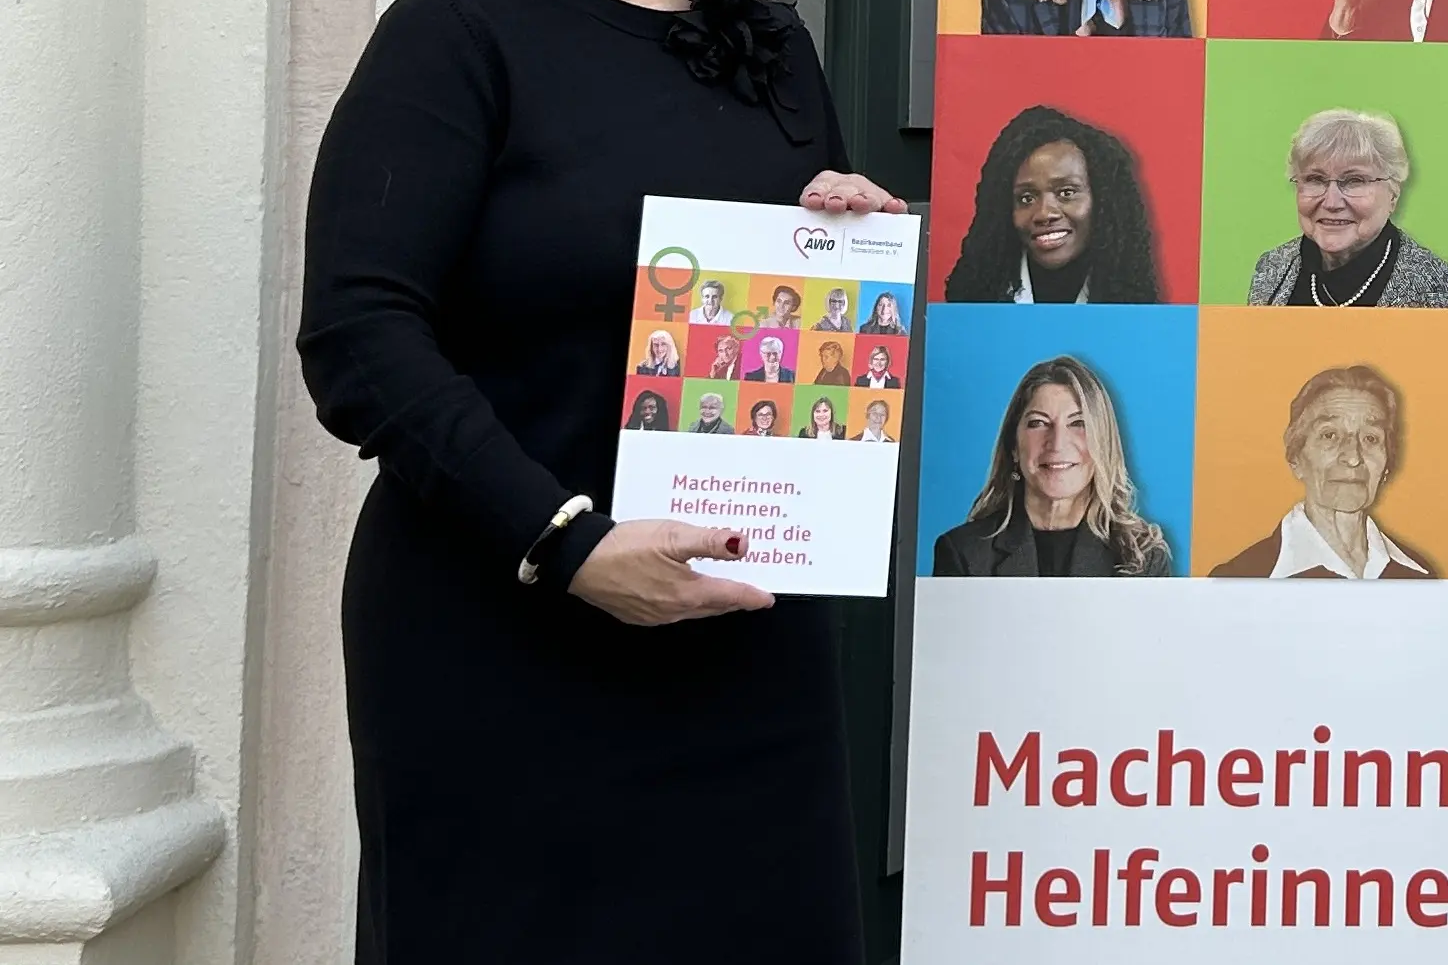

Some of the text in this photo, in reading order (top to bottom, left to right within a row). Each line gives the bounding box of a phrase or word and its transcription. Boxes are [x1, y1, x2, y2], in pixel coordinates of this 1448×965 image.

[804, 237, 835, 251] AWO
[672, 474, 802, 496] Macherinnen.
[670, 498, 788, 518] Helferinnen.
[783, 524, 812, 541] die
